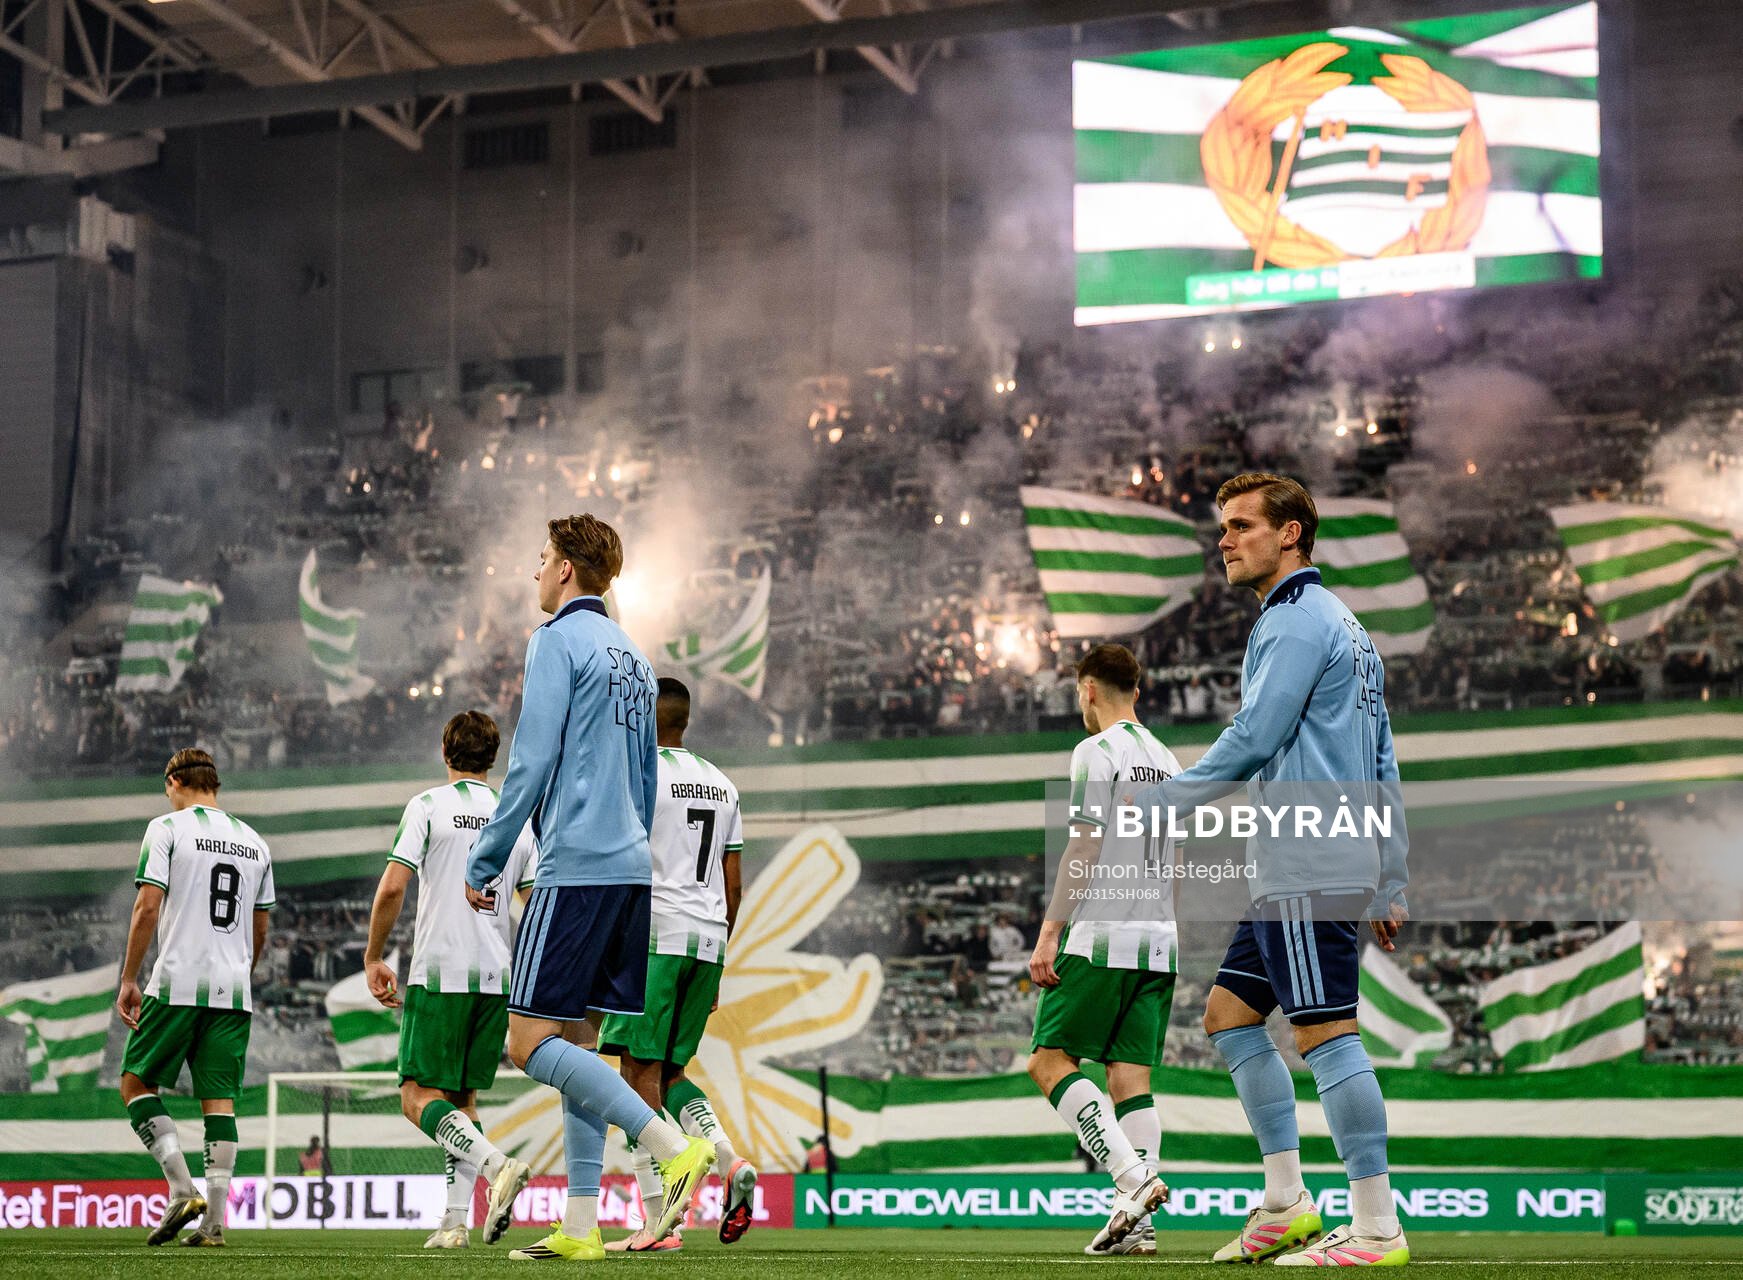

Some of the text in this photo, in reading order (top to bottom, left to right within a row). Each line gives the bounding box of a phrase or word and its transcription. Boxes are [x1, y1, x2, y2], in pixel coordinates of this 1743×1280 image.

[670, 783, 729, 804] ABRAHAM
[195, 838, 259, 861] KARLSSON
[686, 807, 716, 888] 7
[209, 862, 243, 934] 8
[51, 1184, 168, 1229] Finans
[1516, 1187, 1606, 1218] NOR
